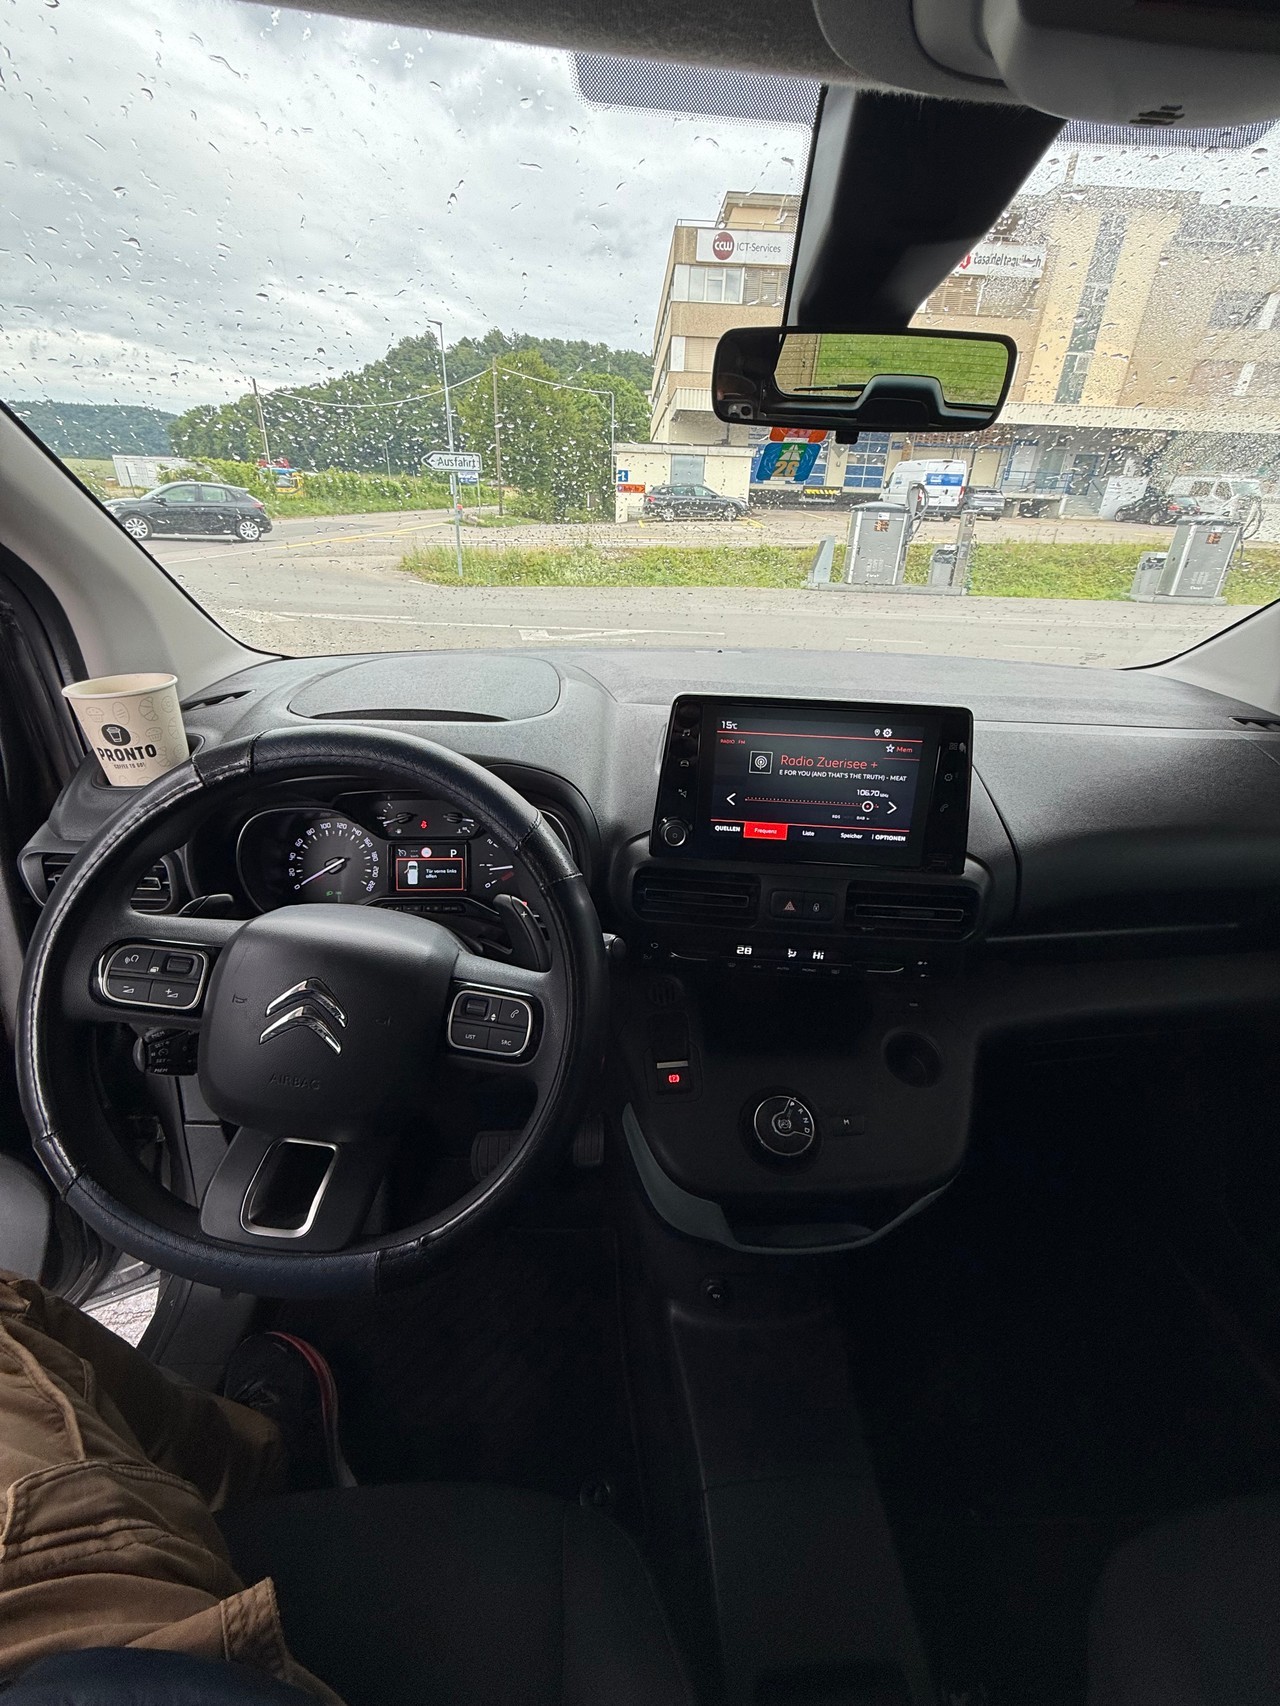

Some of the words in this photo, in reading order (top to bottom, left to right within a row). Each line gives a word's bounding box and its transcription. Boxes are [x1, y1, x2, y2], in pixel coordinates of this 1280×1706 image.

[736, 242, 781, 253] ICT-Services
[437, 456, 476, 468] Ausfahrt
[772, 460, 800, 477] 26
[97, 744, 157, 761] PRONTO
[780, 755, 814, 766] Radio
[817, 756, 867, 769] Zuerisee
[306, 828, 315, 836] 80
[352, 827, 362, 837] 140
[295, 838, 304, 847] 60
[363, 837, 373, 848] 160
[289, 852, 296, 861] 40
[450, 849, 457, 858] P
[288, 868, 295, 877] 20
[366, 880, 376, 892] 220
[736, 945, 752, 955] 28
[812, 950, 824, 960] Hi
[270, 1074, 320, 1090] AIRBAG
